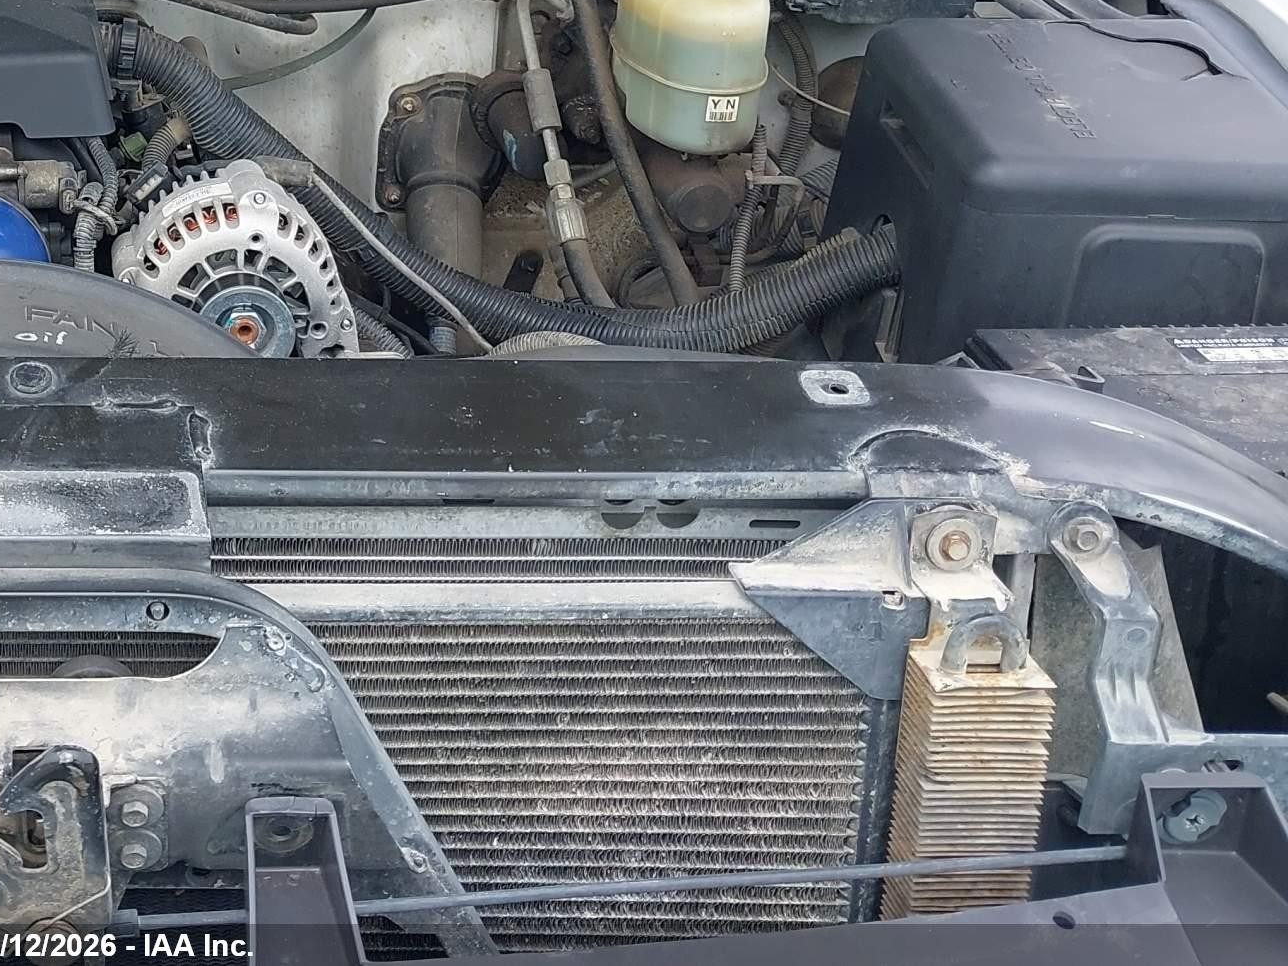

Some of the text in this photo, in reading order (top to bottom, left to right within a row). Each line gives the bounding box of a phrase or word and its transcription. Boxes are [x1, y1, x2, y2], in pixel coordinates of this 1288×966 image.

[711, 98, 736, 110] Y N
[24, 305, 121, 342] FAN
